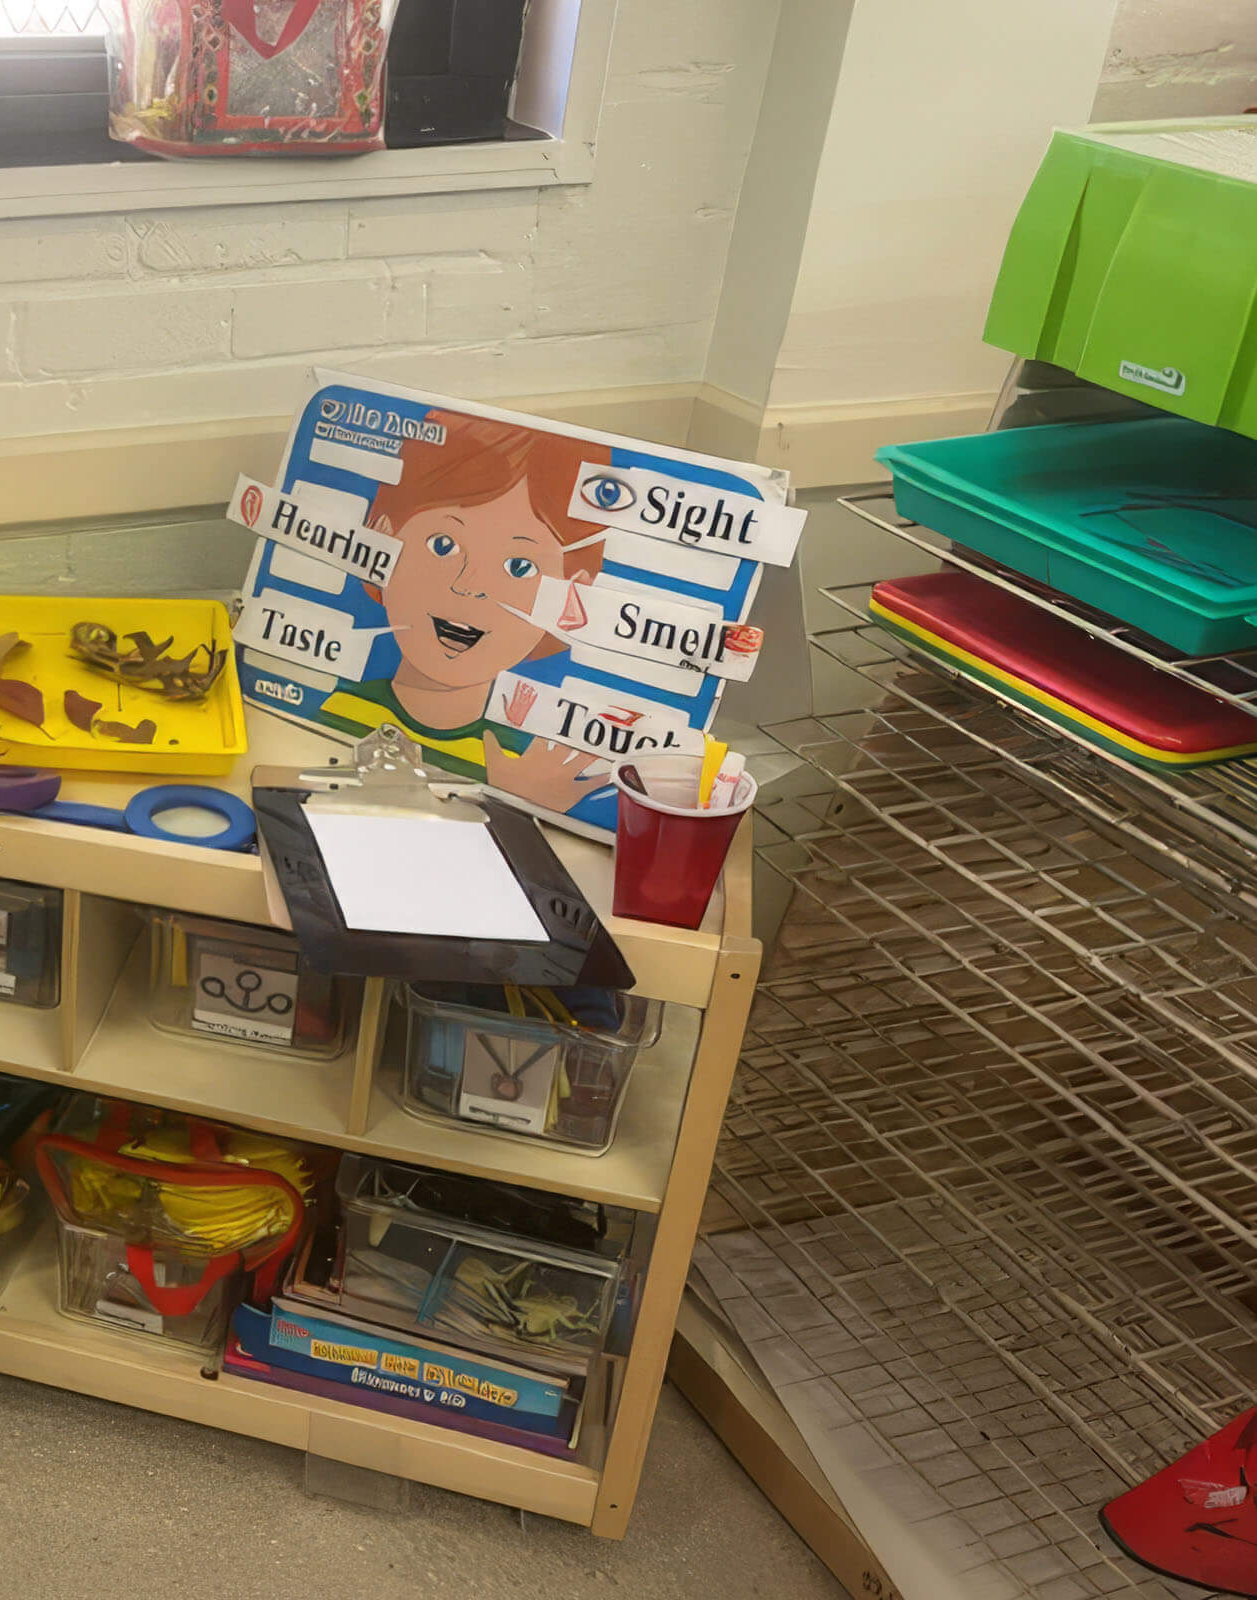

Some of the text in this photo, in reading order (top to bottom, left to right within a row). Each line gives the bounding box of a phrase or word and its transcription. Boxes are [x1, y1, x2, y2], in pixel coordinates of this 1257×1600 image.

[271, 499, 392, 582] Hearing
[639, 485, 759, 548] Sight
[261, 607, 342, 662] Taste
[614, 602, 727, 664] Smell
